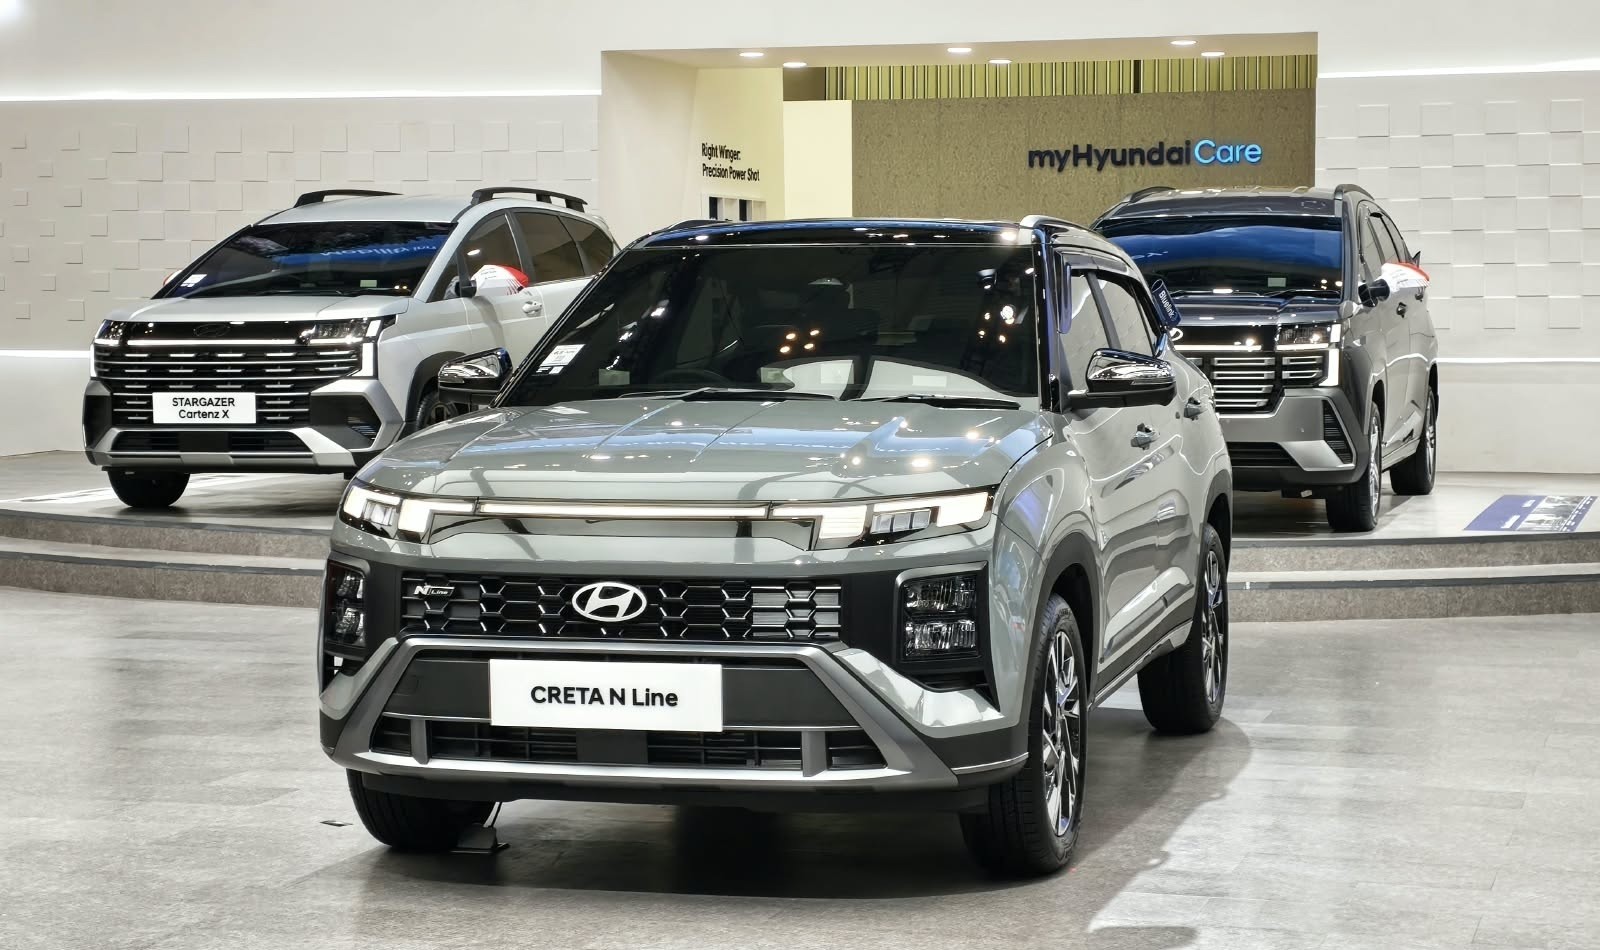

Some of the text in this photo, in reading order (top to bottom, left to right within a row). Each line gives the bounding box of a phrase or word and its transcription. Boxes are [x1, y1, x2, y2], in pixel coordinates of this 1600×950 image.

[701, 142, 718, 161] Right
[702, 162, 760, 182] Precision Power Shot
[1158, 290, 1175, 319] Bluelink
[172, 397, 236, 407] STARGAZER
[178, 409, 230, 419] Cartenz X
[530, 685, 679, 707] CRETA N Line
